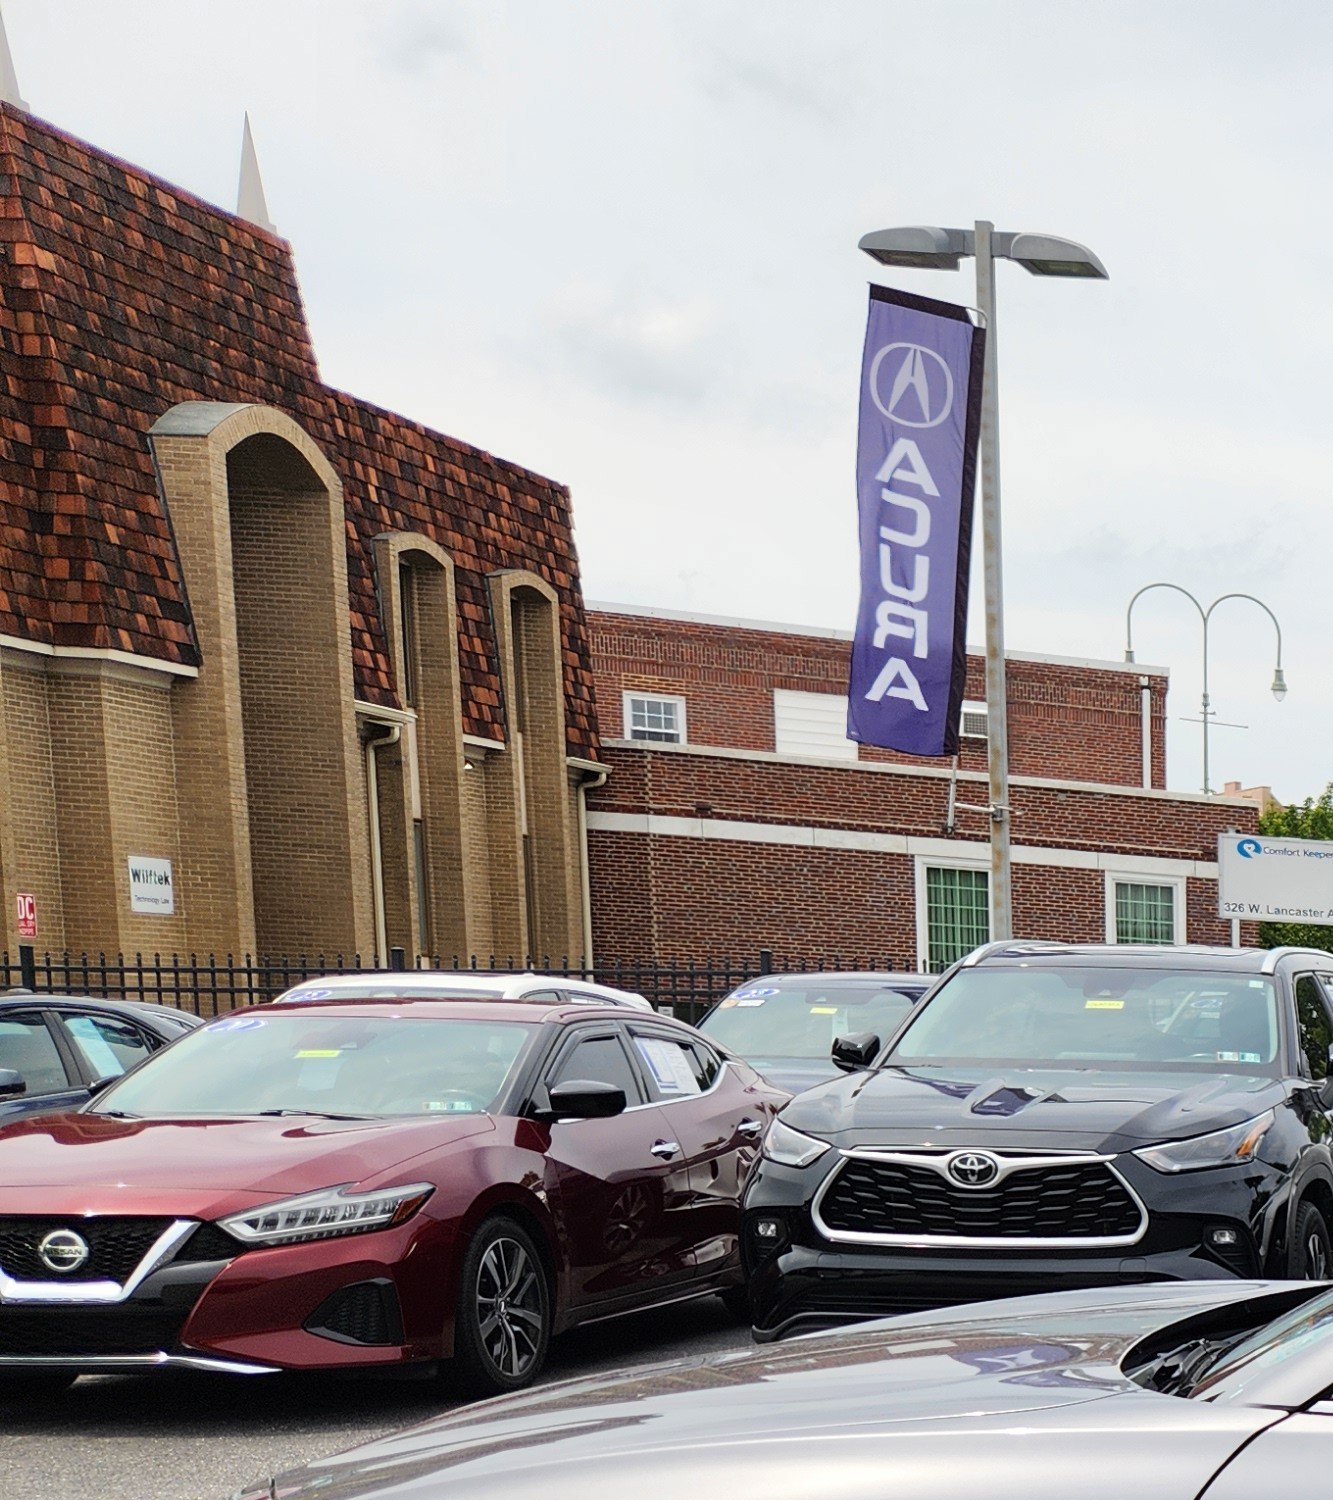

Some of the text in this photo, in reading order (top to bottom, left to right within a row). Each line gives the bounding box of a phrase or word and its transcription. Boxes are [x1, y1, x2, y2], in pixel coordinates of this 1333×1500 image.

[1263, 846, 1300, 857] Comfort
[131, 868, 171, 886] Wilftek
[1224, 902, 1245, 913] 326
[1248, 903, 1263, 914] W.
[1266, 905, 1324, 918] Lancaster
